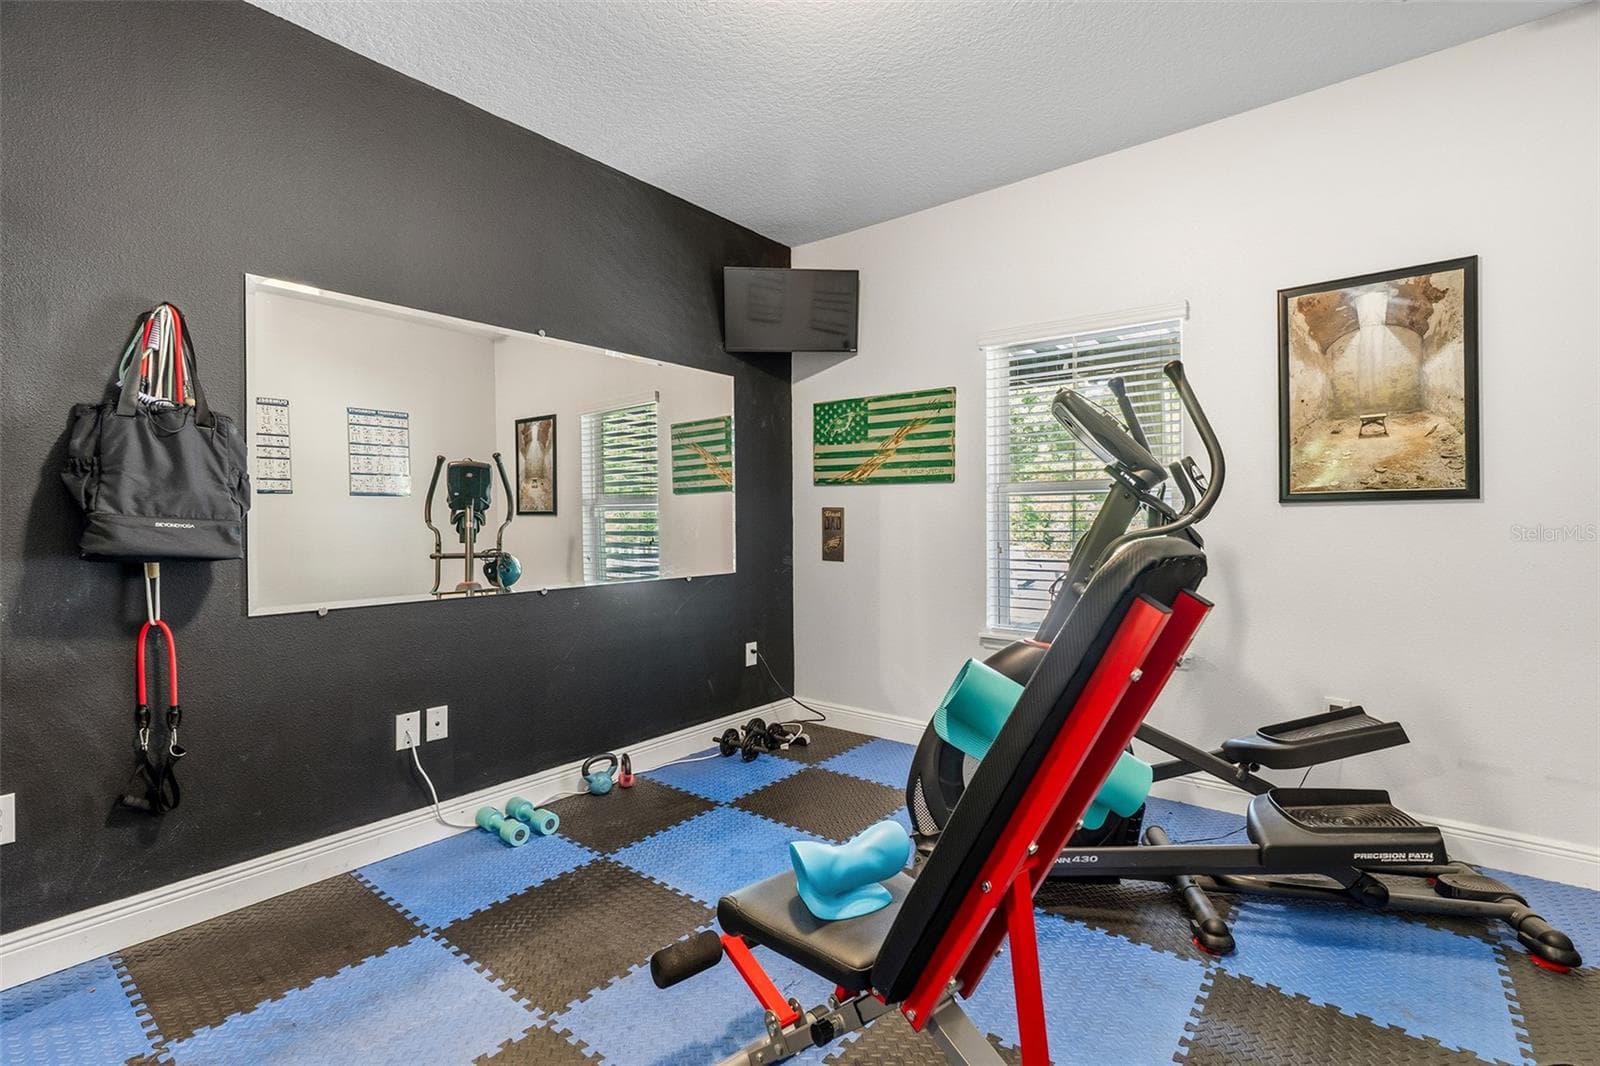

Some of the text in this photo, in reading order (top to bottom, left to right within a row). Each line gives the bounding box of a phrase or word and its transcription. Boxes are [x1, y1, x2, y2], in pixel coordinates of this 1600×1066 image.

[824, 517, 842, 530] DAD
[1071, 855, 1099, 863] 430
[1353, 852, 1434, 860] PRECISION PATH
